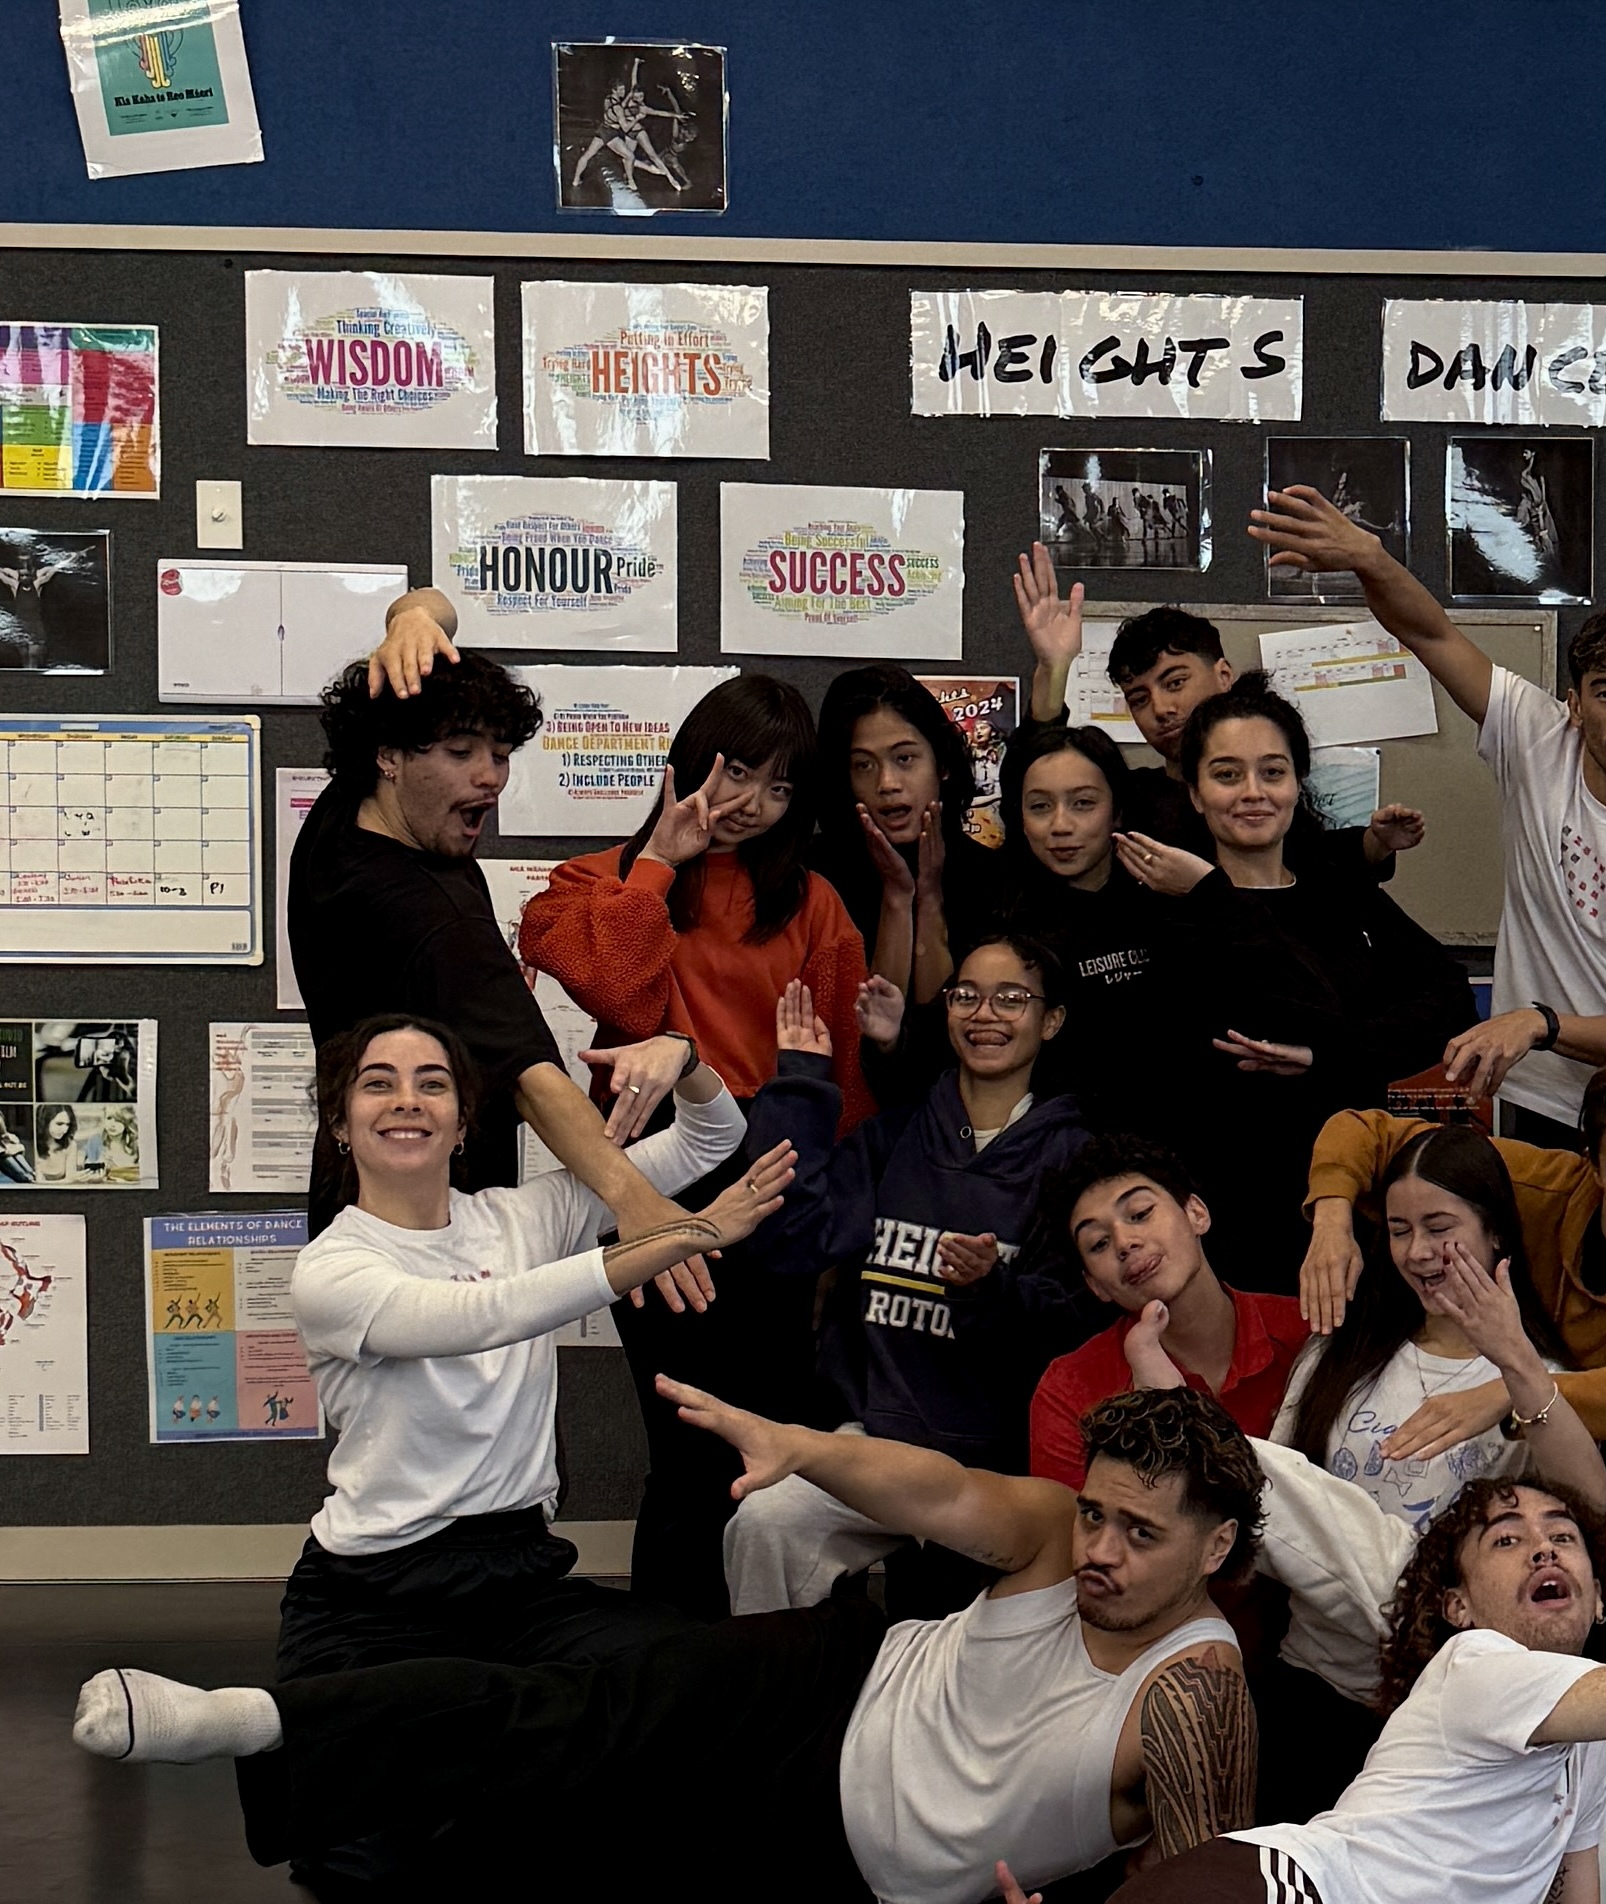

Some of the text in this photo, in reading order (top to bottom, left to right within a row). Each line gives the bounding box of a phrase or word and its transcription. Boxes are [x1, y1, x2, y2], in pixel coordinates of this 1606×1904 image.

[336, 319, 435, 338] Thinking Creatively
[620, 330, 660, 346] Putting
[678, 331, 709, 347] Effort
[306, 339, 444, 388] WISDOM
[592, 350, 721, 396] HEIGHTS
[317, 387, 434, 403] Making The Right Choices
[480, 545, 656, 594] HONOUR Pride
[768, 549, 906, 597] SUCCESS
[953, 696, 1004, 722] 2024
[543, 735, 579, 751] DANCE
[582, 735, 654, 751] DEPARTMENT
[562, 752, 571, 767] 1)
[573, 753, 633, 767] RESPECTING
[559, 773, 655, 788] 2) INCLUDE PEOPLE
[1079, 951, 1127, 977] LEISURE
[164, 1219, 303, 1233] THE ELEMENTS OF DANCE
[188, 1234, 277, 1246] RELATIONSHIPS
[865, 1289, 956, 1339] ROTO
